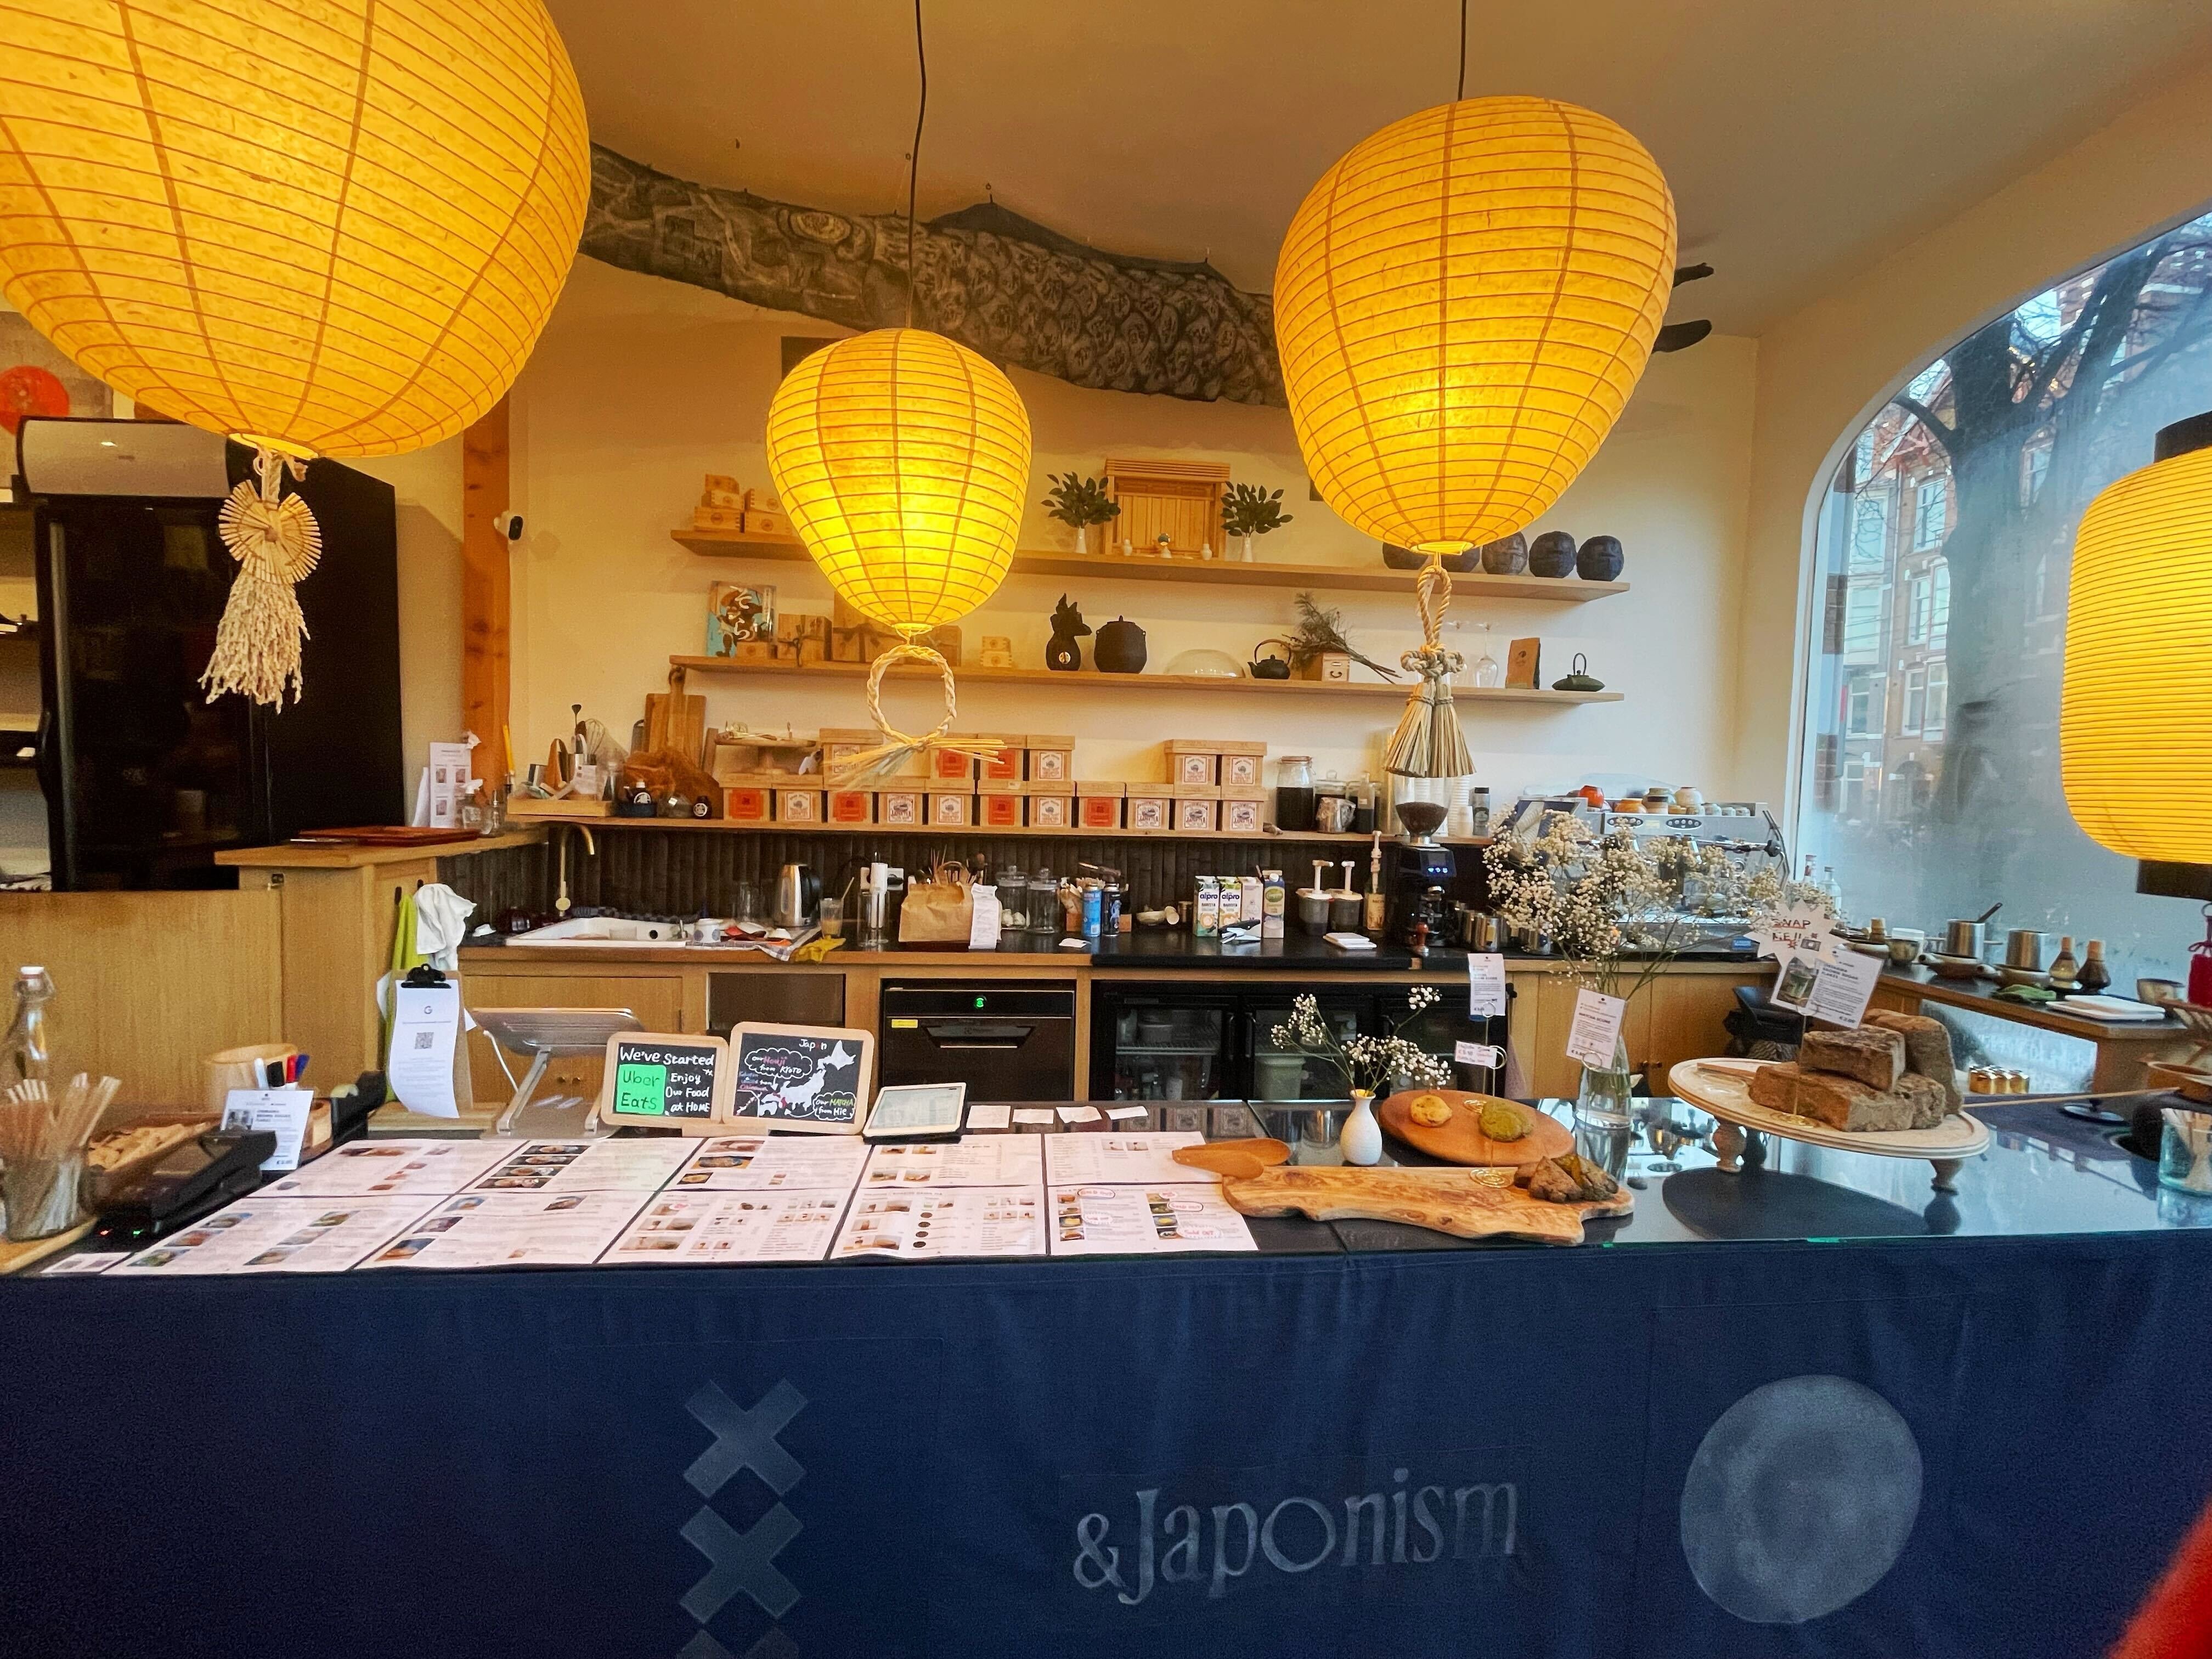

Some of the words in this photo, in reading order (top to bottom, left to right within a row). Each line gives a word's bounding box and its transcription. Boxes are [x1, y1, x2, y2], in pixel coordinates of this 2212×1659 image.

[1200, 893, 1218, 901] alpro
[1222, 893, 1240, 901] alpro
[424, 1006, 433, 1014] G
[620, 1046, 661, 1062] We've
[663, 1053, 714, 1065] Started
[623, 1070, 659, 1087] Uber
[670, 1073, 701, 1085] Enjoy
[665, 1086, 683, 1098] Our
[686, 1087, 710, 1098] Food
[621, 1092, 657, 1110] Eats
[670, 1103, 684, 1113] at
[1073, 1468, 1518, 1605] &Japonism
